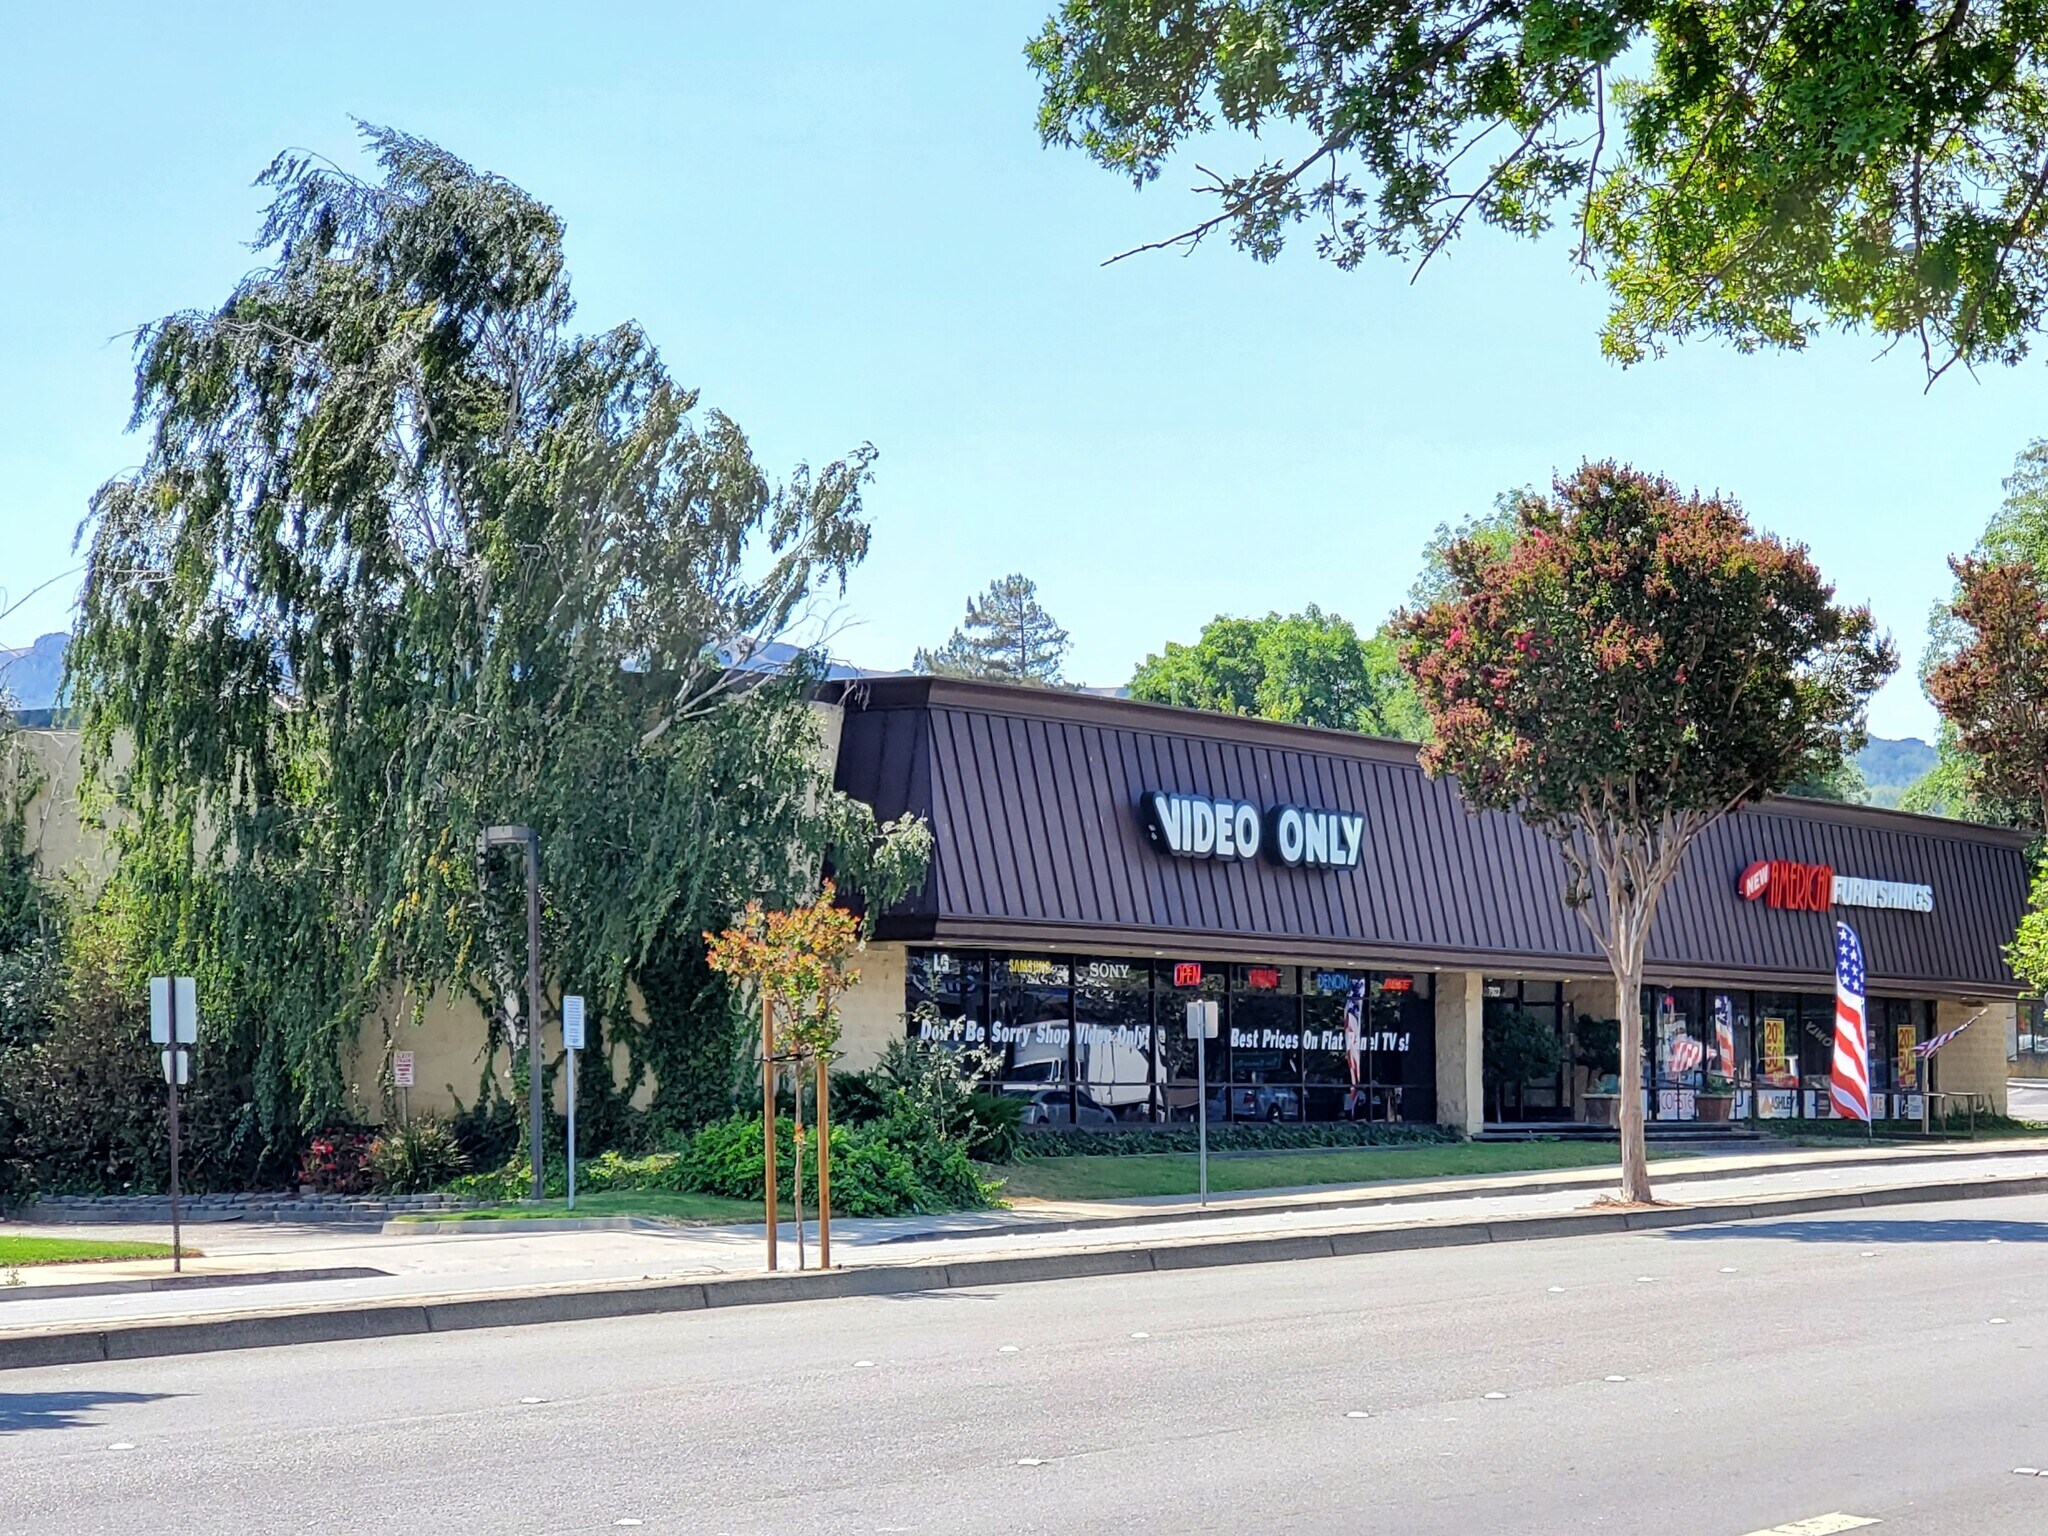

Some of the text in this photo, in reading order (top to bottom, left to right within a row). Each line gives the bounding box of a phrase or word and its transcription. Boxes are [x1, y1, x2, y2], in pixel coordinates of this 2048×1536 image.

[1154, 795, 1364, 867] VIDEO ONLY
[1746, 861, 1933, 913] NEW AMERICAN FURNISHINGS
[933, 953, 950, 974] LG
[1008, 958, 1051, 974] SAMSUNG
[1089, 962, 1130, 979] SONY
[1175, 964, 1200, 986] OPEN
[1317, 974, 1348, 990] DENON
[965, 1020, 986, 1042] Be
[991, 1020, 1031, 1048] Sorry
[1035, 1023, 1070, 1049] Shop
[1077, 1023, 1112, 1045] Video
[1230, 1027, 1259, 1049] Best
[1262, 1029, 1299, 1050] Prices
[1302, 1030, 1318, 1051] On
[1321, 1030, 1343, 1051] Flat
[1771, 1095, 1796, 1110] ASHLEY
